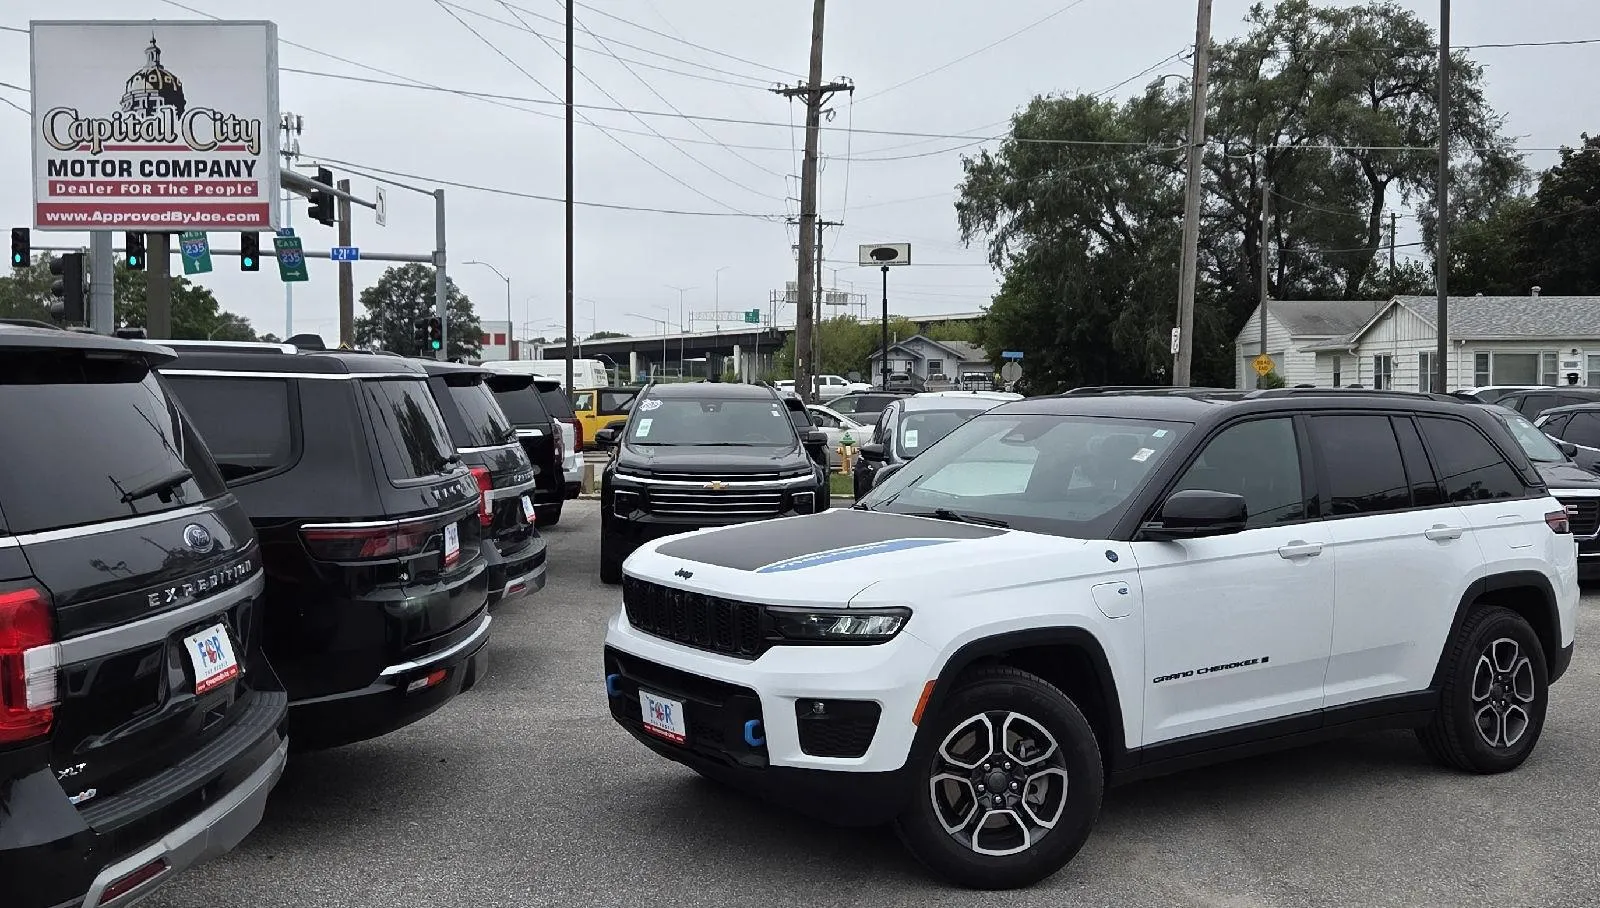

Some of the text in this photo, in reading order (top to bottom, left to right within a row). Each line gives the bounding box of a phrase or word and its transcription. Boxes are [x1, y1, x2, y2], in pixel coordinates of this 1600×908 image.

[43, 106, 262, 156] Capital City
[48, 159, 257, 178] MOTOR COMPANY
[56, 183, 253, 196] Dealer FOR The People
[46, 211, 260, 224] www.ApprovedByJoe.com
[185, 243, 205, 254] 235
[283, 253, 300, 262] 235
[675, 568, 694, 580] Jeep
[148, 560, 252, 607] EXPEDITION
[1153, 658, 1259, 683] GRAND CHEROKEE
[58, 762, 87, 780] XLT
